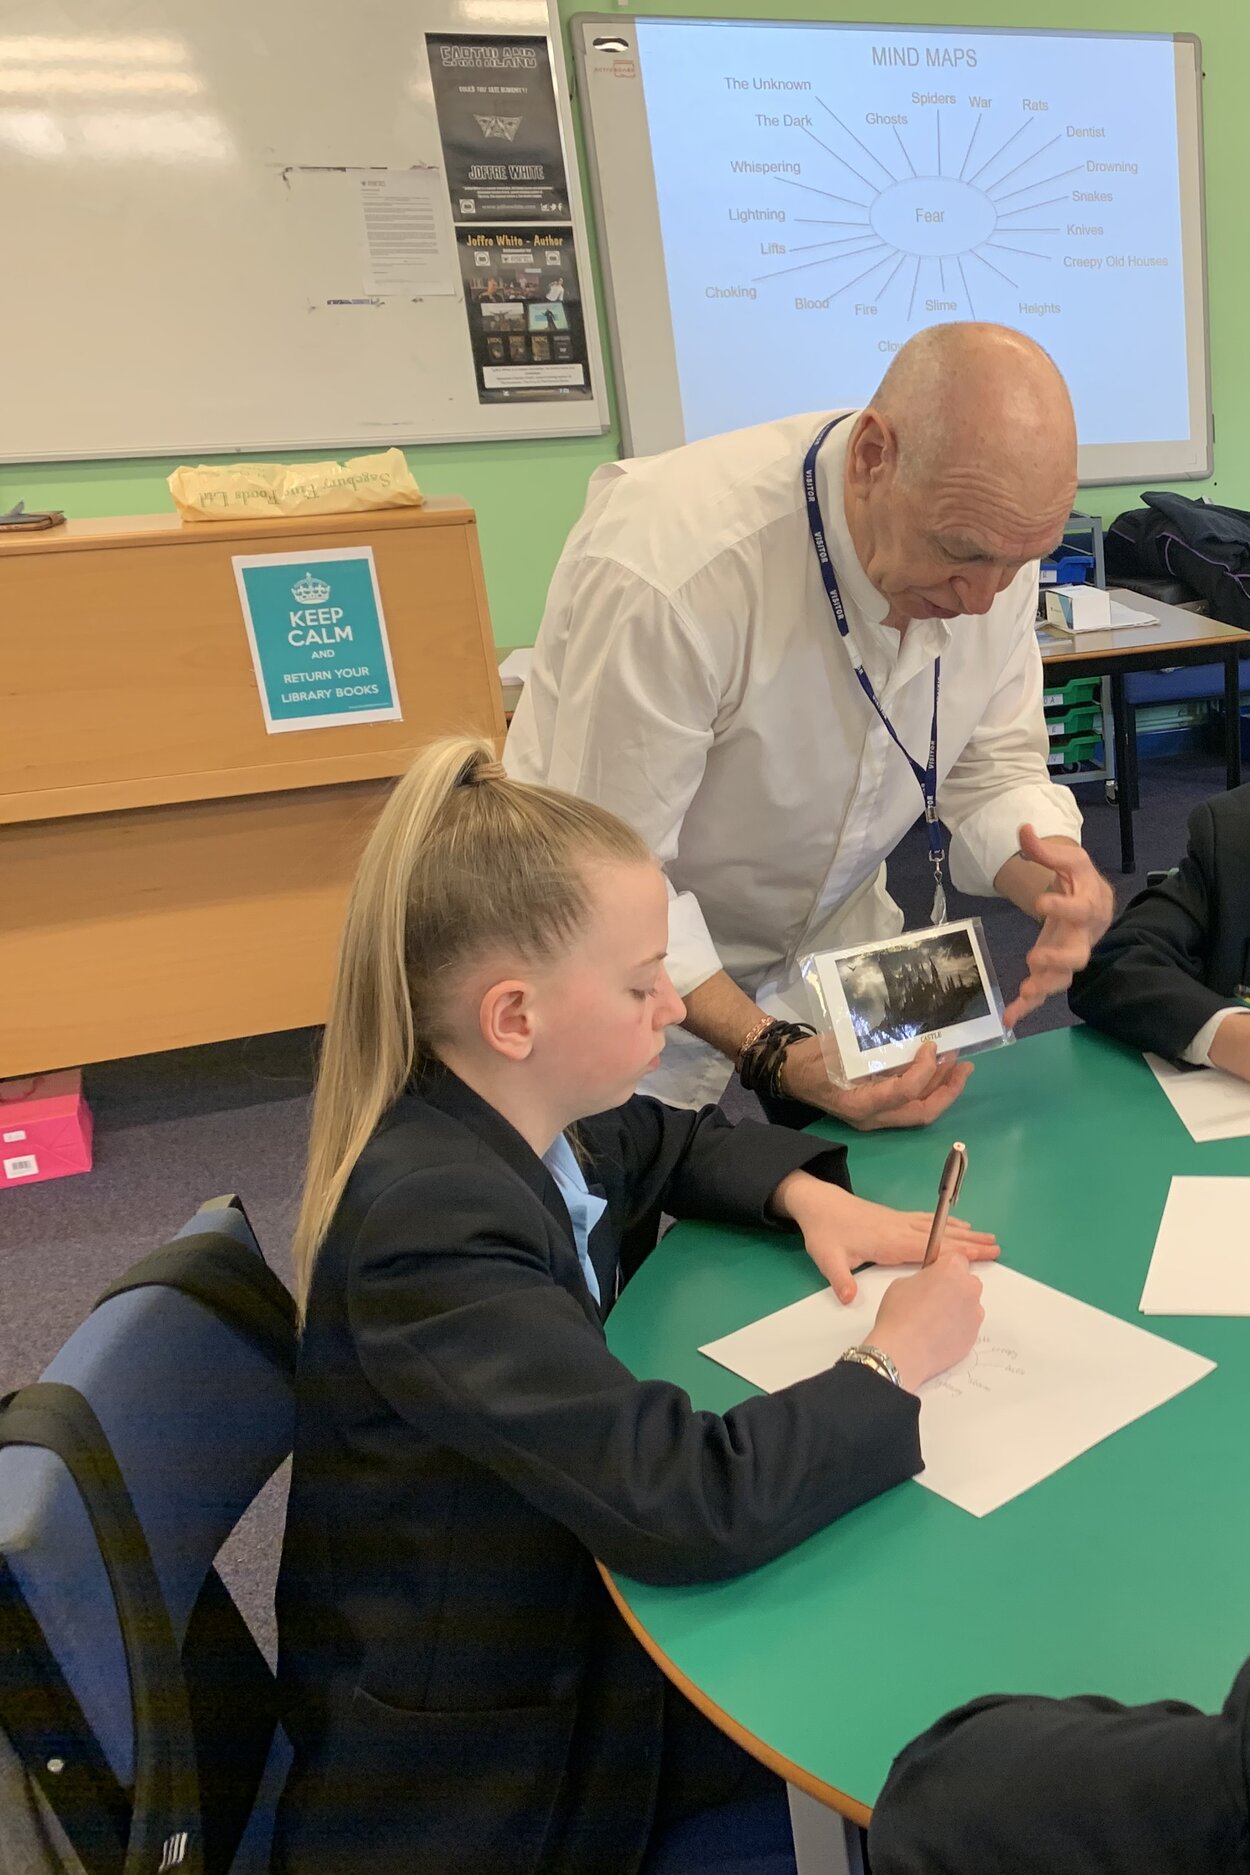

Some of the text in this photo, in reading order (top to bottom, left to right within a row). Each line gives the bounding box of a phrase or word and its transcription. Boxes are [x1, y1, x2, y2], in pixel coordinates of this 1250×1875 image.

[872, 46, 977, 68] MIND MAPS
[724, 77, 812, 90] The Unknown
[911, 92, 957, 106] Spiders
[968, 95, 993, 108] War
[1022, 98, 1049, 111] Rats
[755, 114, 813, 127] The Dark
[865, 112, 908, 125] Ghosts
[1066, 125, 1105, 138] Dentist
[468, 164, 545, 180] JOFFRE WHITE
[730, 160, 801, 175] Whispering
[1086, 160, 1138, 174] Drowning
[1072, 190, 1113, 202] Snakes
[728, 208, 786, 223] Lightning
[915, 208, 945, 223] Fear
[1066, 224, 1104, 236] Knives
[466, 235, 494, 247] Joffre
[496, 234, 523, 247] White
[533, 234, 564, 247] Author
[760, 242, 786, 255] Lifts
[1063, 255, 1169, 269] Creepy Old Houses
[705, 285, 757, 300] Choking
[794, 297, 830, 310] Blood
[855, 303, 878, 316] Fire
[925, 299, 957, 312] Slime
[1018, 302, 1061, 317] Heights
[805, 469, 816, 502] VISITOR
[200, 490, 229, 508] Ltd
[235, 489, 281, 506] Foods
[814, 531, 829, 563] VISITOR
[829, 589, 845, 620] VISITOR
[289, 607, 343, 628] KEEP
[287, 625, 353, 647] CALM
[311, 649, 335, 660] AND
[283, 666, 370, 684] RETURN YOUR
[281, 684, 379, 703] LIBRARY BOOKS
[920, 1032, 942, 1043] CASTLE
